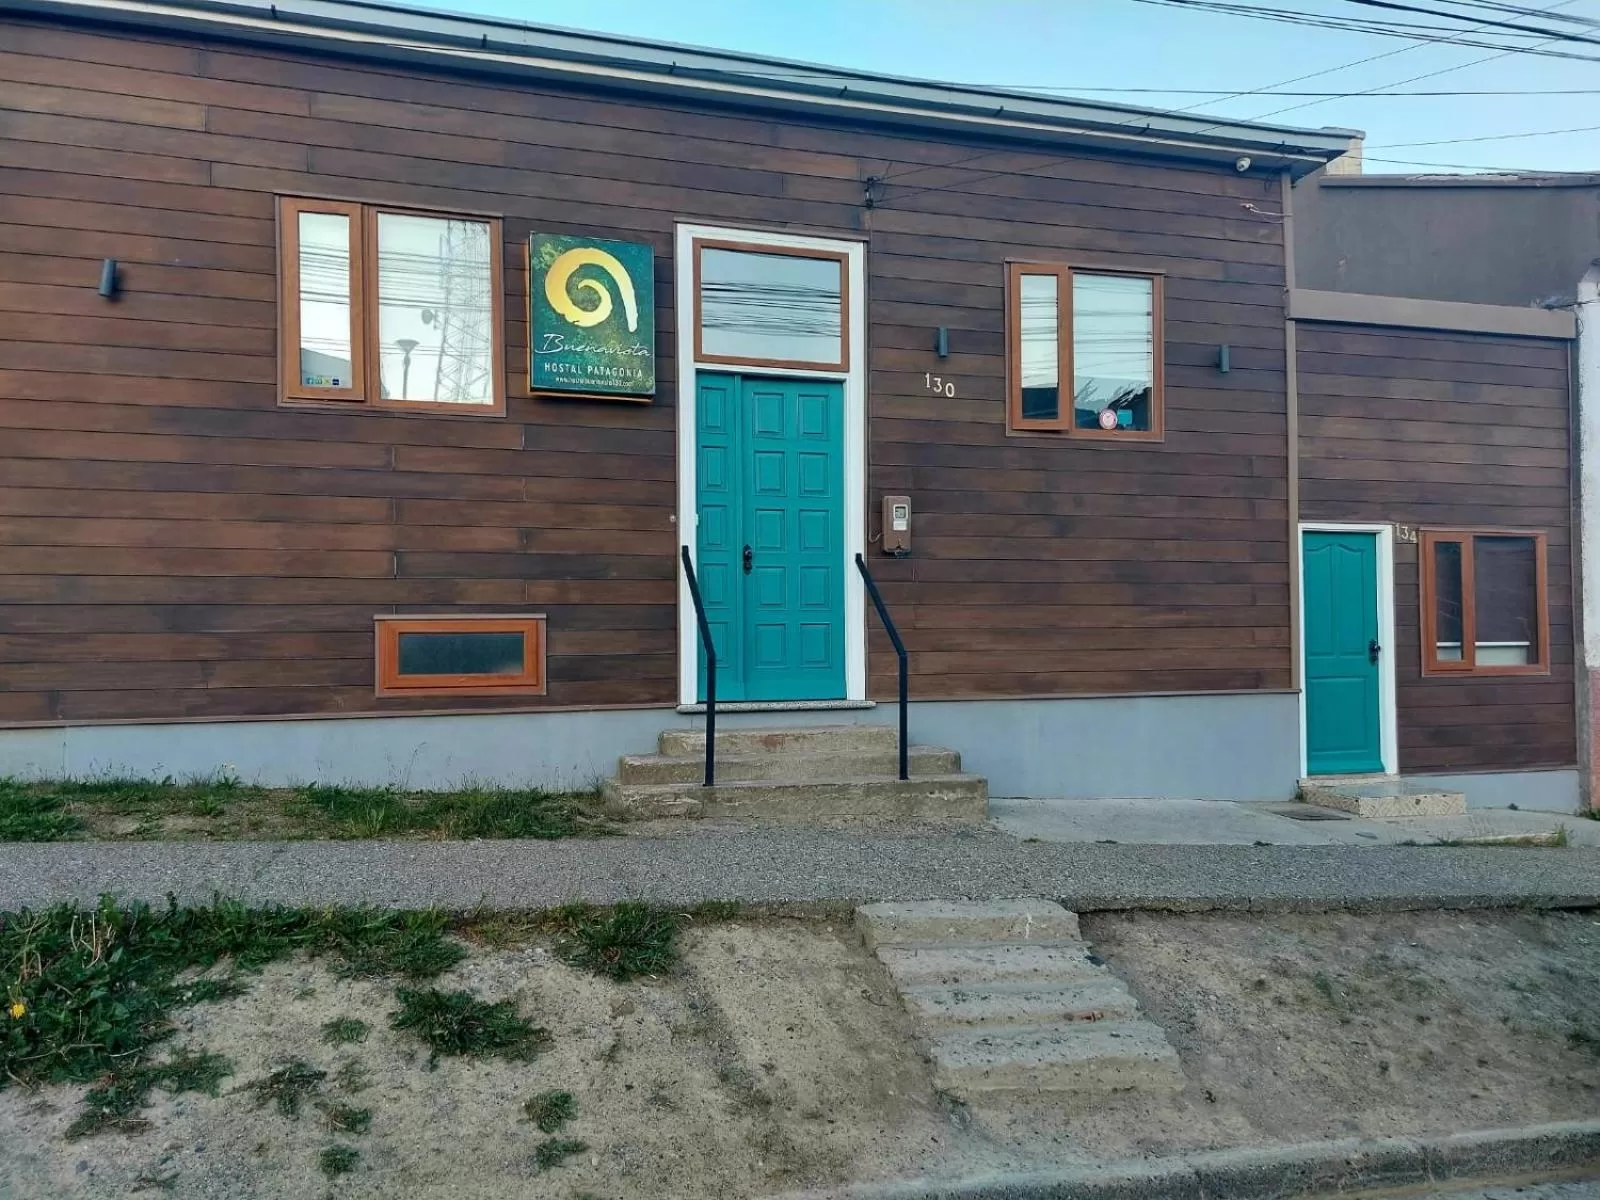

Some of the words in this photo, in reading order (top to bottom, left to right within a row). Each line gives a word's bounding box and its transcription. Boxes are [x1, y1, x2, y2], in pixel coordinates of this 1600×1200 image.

[535, 333, 652, 356] Buenavista
[544, 362, 582, 375] HOSTAL
[587, 365, 642, 379] PATAGONIA
[925, 373, 955, 397] 130
[1395, 522, 1418, 544] 134
